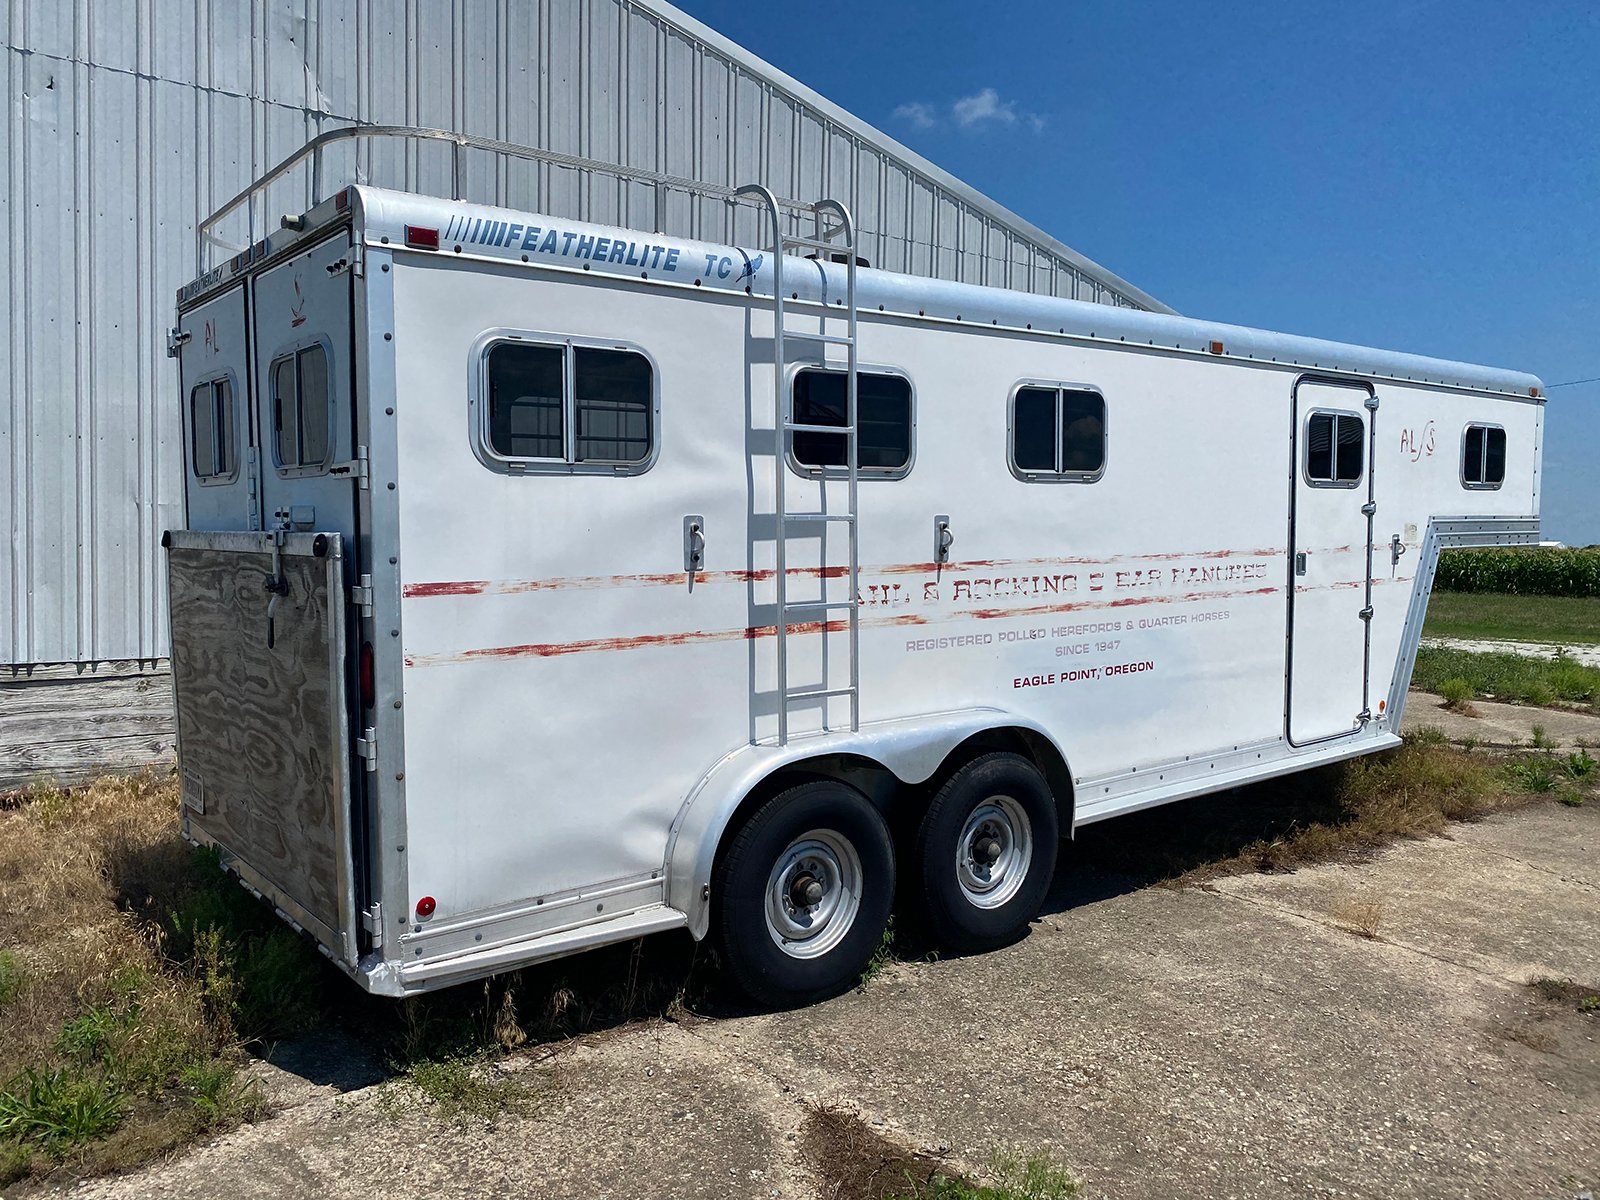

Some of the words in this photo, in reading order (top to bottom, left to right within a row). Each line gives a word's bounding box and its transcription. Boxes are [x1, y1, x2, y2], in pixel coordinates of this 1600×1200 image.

[504, 223, 680, 271] FEATHERLITE
[705, 254, 732, 279] TC
[906, 633, 993, 652] REGISTERED
[998, 628, 1046, 643] POLLED
[1051, 622, 1121, 638] HEREFORDS
[1126, 620, 1134, 630] &
[1139, 615, 1187, 629] QUARTER
[1191, 610, 1230, 623] HORSES
[1055, 643, 1090, 657] SINCE
[1094, 640, 1121, 652] 1947
[1013, 674, 1056, 689] EAGLE
[1060, 668, 1100, 683] POINT,
[1104, 661, 1154, 676] OREGON
